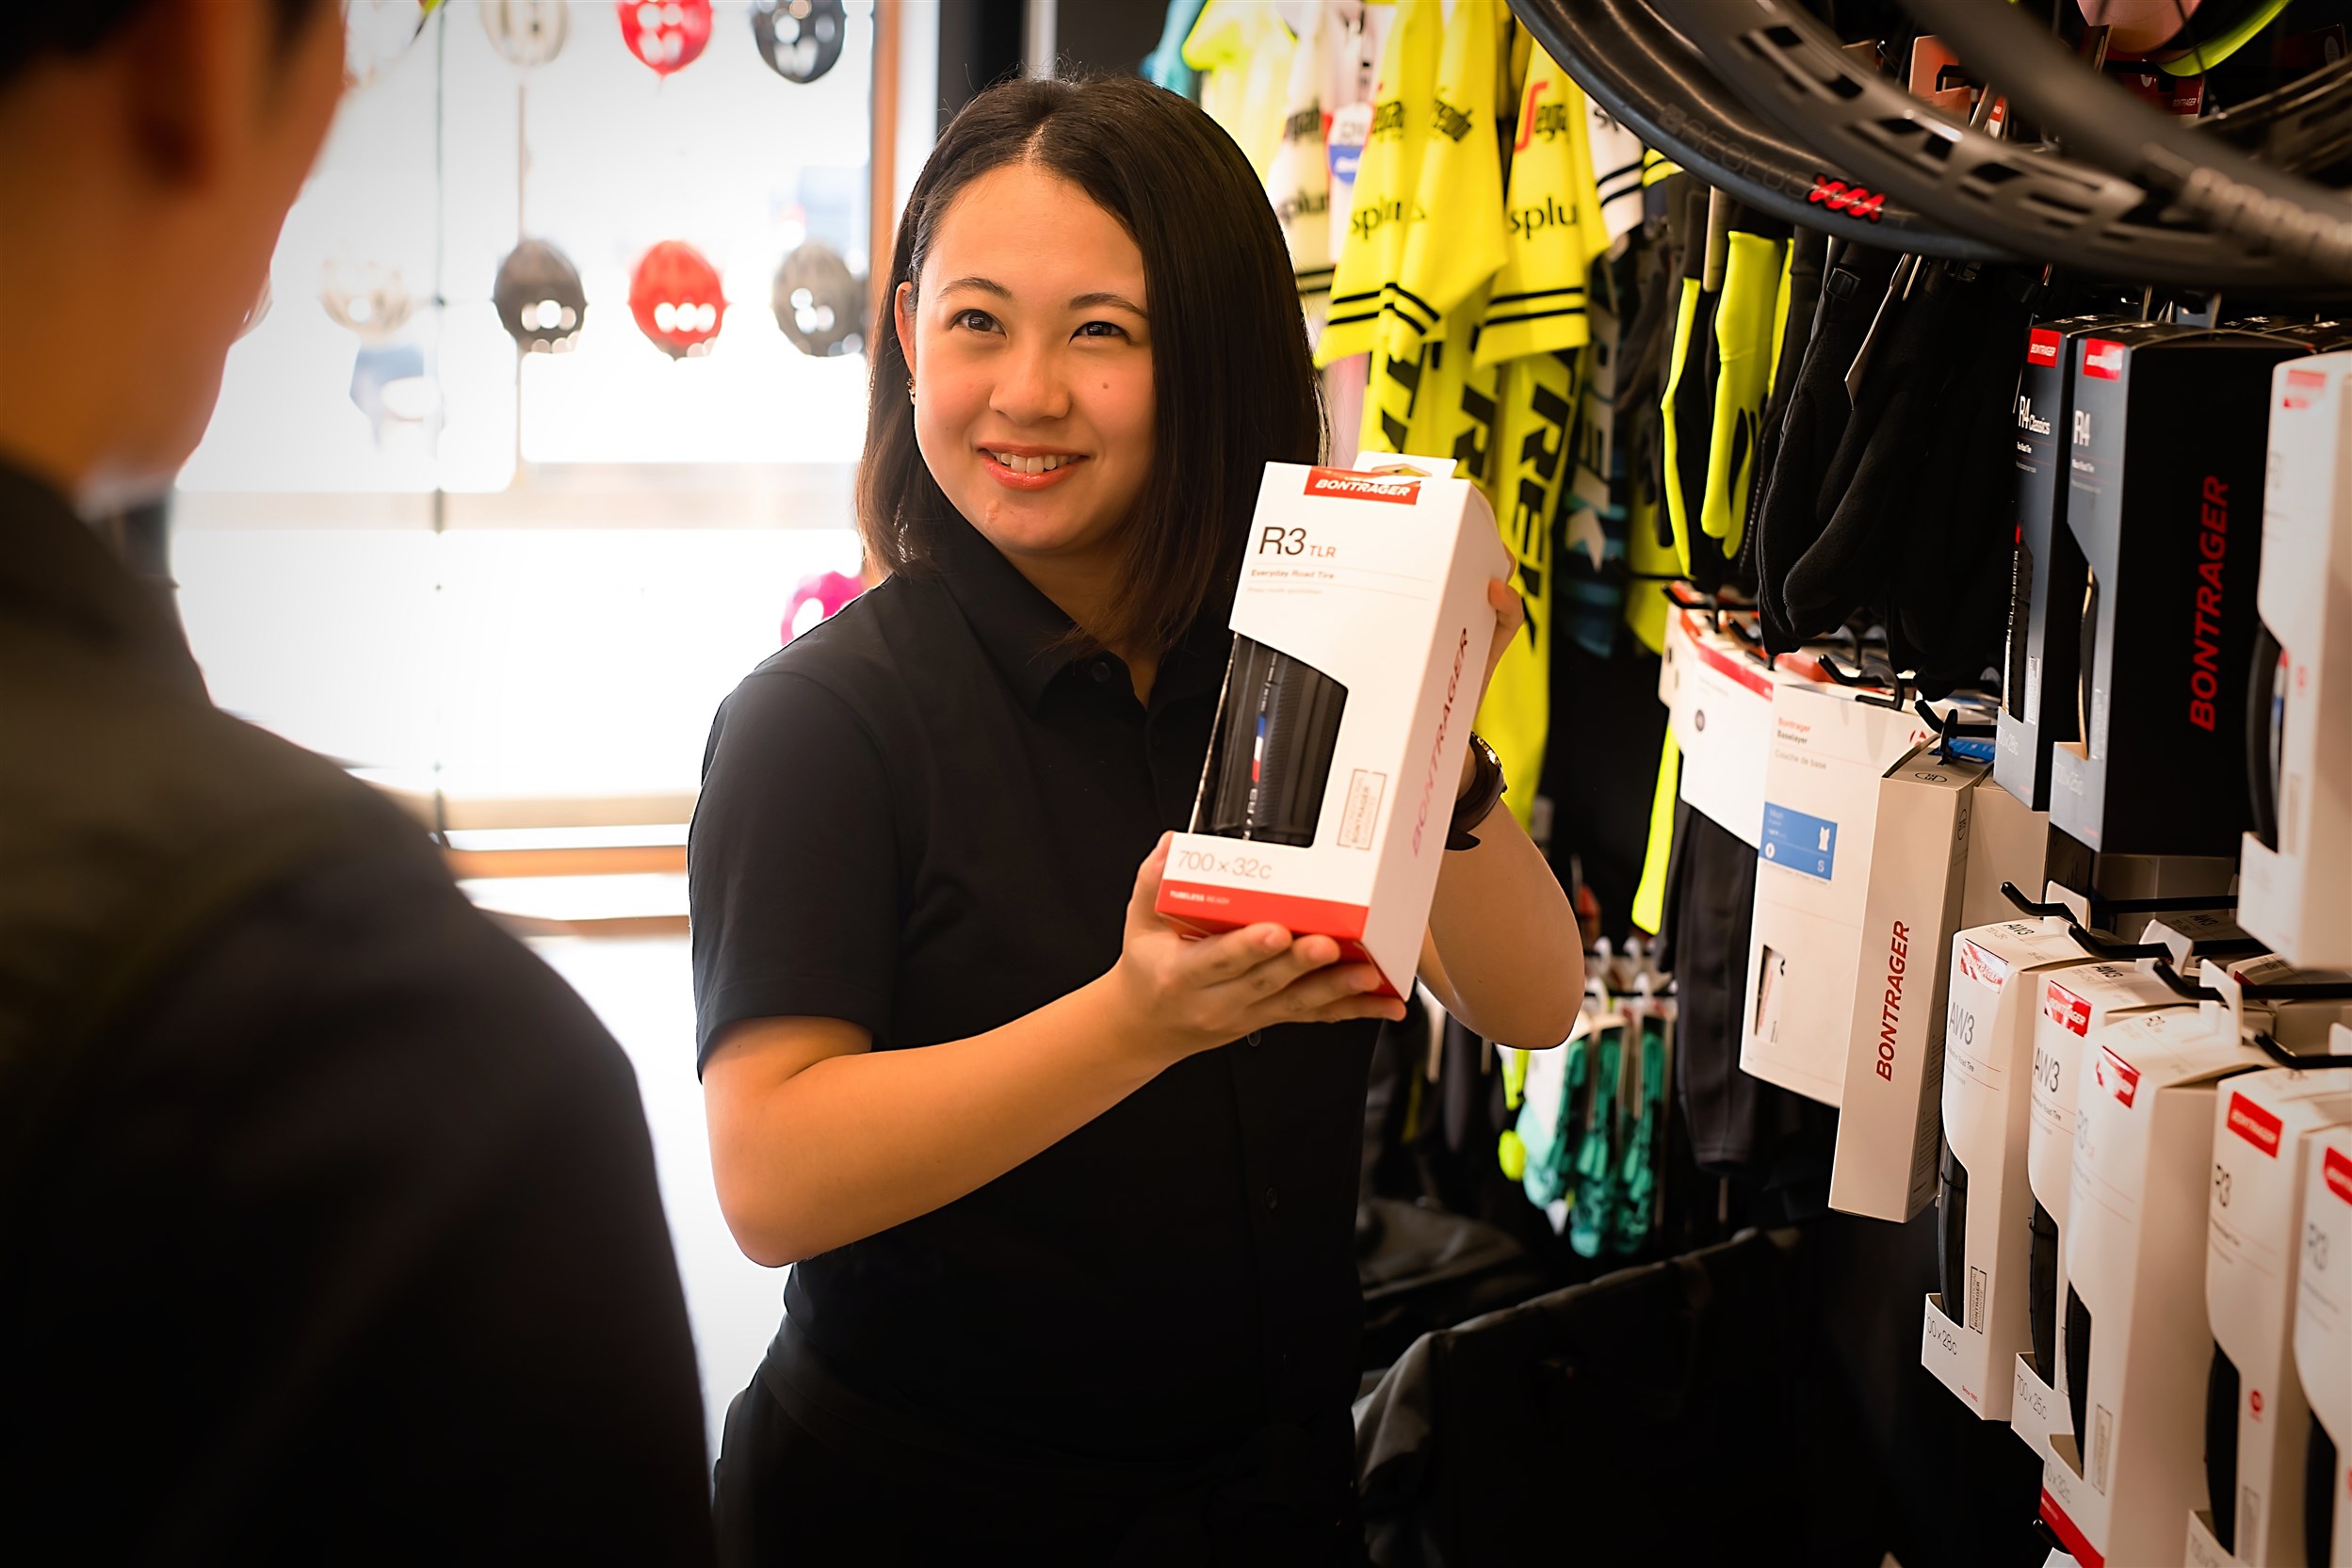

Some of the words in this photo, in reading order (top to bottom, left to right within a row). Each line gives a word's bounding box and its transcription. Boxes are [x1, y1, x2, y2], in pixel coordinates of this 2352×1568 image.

[2018, 395, 2032, 429] R4
[2073, 409, 2092, 447] R4
[1315, 478, 1411, 496] BONTRAGER
[1258, 525, 1306, 556] R3
[1309, 544, 1337, 558] TLR
[1291, 570, 1315, 578] Road
[2189, 475, 2230, 732] BONTRAGER
[1413, 627, 1468, 859] BONTRAGER
[1776, 729, 1809, 744] Baselayer
[1777, 717, 1811, 733] Bontrager
[1875, 920, 1910, 1082] BONTRAGER
[1948, 1001, 1975, 1045] AW3
[2033, 1046, 2060, 1093] AW3
